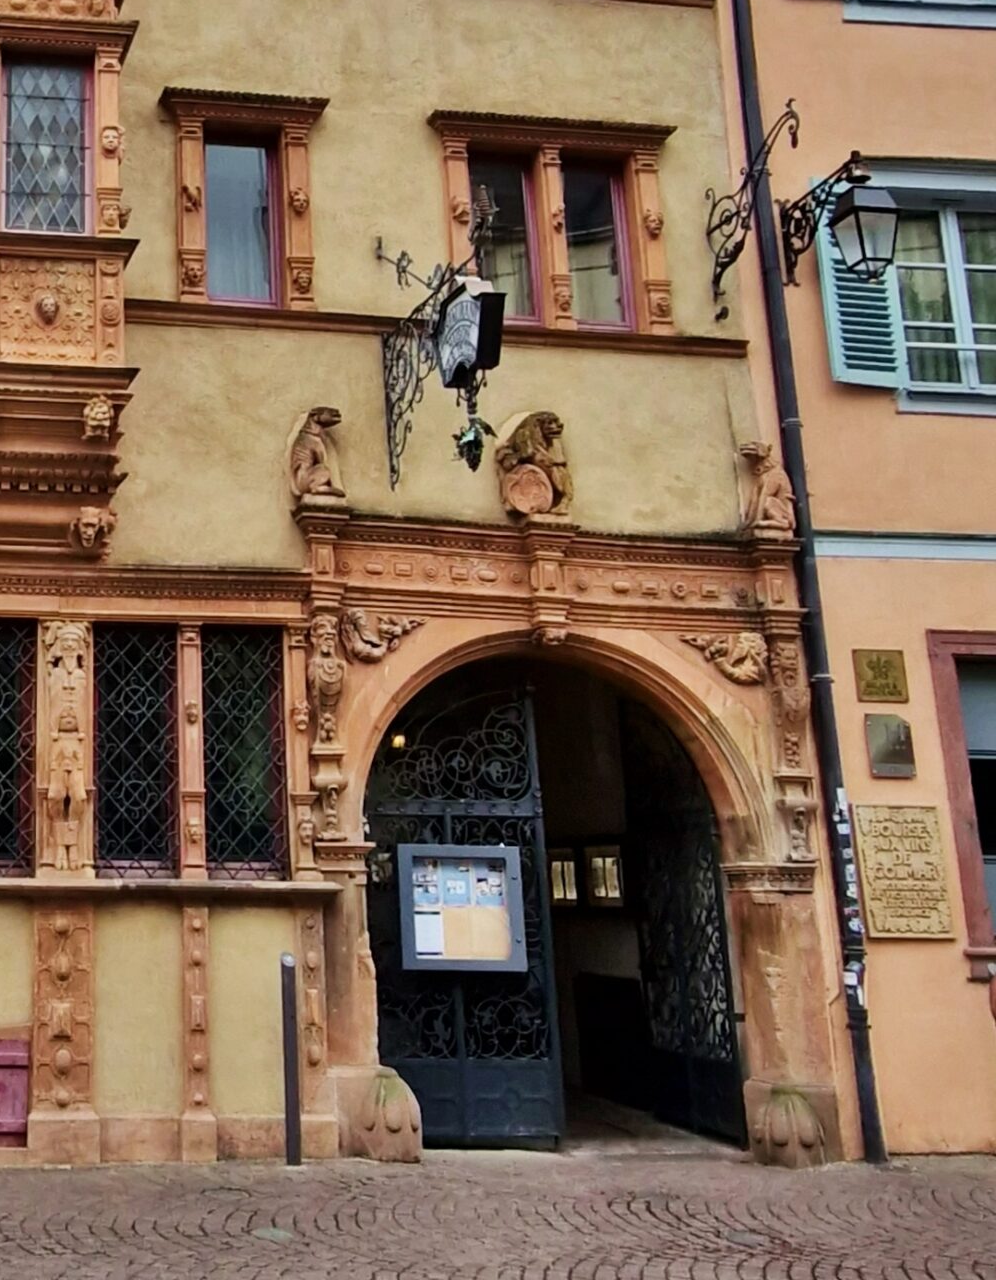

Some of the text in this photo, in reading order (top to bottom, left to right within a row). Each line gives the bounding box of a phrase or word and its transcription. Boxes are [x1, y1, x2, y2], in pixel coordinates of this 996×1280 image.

[871, 823, 928, 838] BOURSE
[901, 839, 932, 853] VINS
[892, 852, 912, 867] DE
[874, 864, 939, 880] COLMAR
